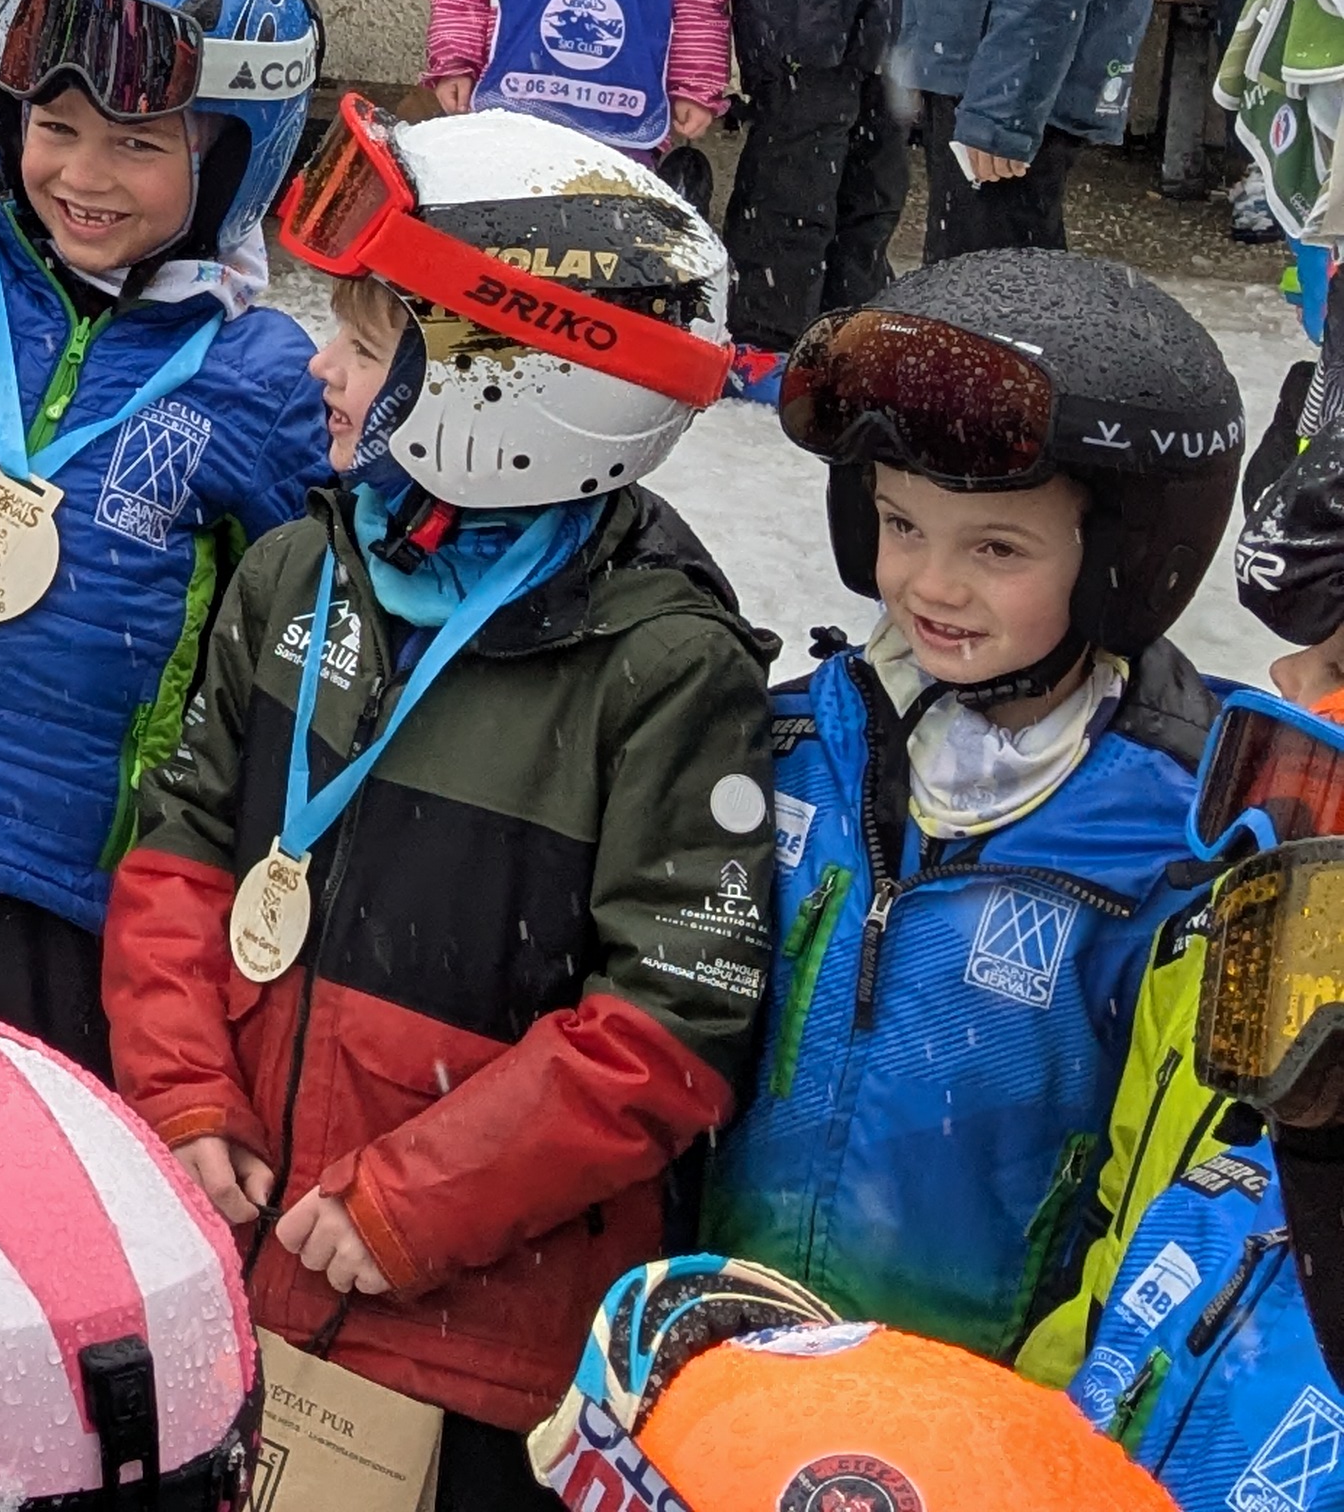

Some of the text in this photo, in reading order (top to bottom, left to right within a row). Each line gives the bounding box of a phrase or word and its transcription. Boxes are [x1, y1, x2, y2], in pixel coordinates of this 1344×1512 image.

[525, 79, 639, 109] 06 34 11 07 20
[462, 274, 619, 352] BRIKO
[704, 896, 760, 920] L.C.A
[267, 1383, 356, 1439] 'ÉTAT PUR
